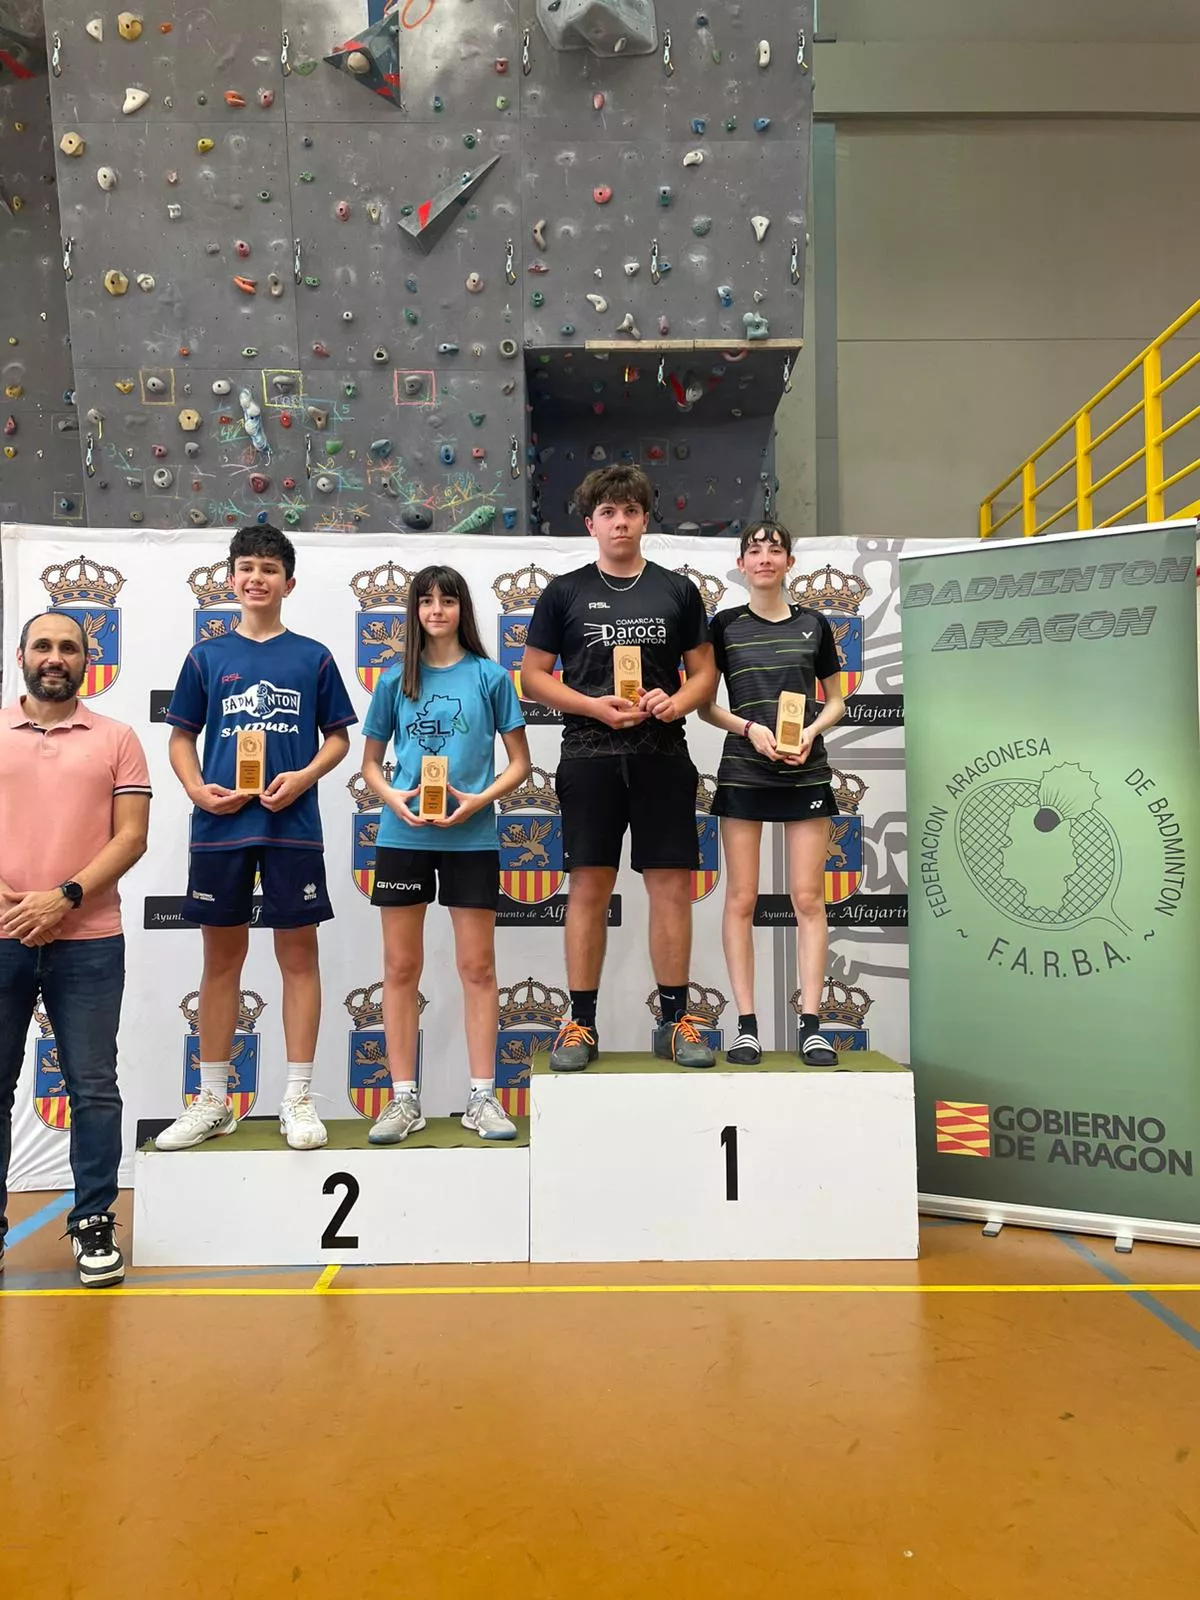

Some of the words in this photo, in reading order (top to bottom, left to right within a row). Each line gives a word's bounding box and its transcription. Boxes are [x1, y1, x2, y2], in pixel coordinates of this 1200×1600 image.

[902, 555, 1193, 610] BADMINTON
[588, 601, 611, 610] RSL
[602, 624, 667, 639] Daroca
[615, 618, 654, 626] COMARCA
[655, 617, 666, 625] DE
[931, 605, 1157, 652] ARAGON
[603, 638, 667, 647] BADMINTON
[405, 719, 451, 740] RSL
[921, 805, 952, 918] FEDERACION
[945, 737, 1051, 800] ARAGONESA
[1125, 768, 1156, 797] DE
[1147, 797, 1187, 917] BADMINTON
[376, 880, 422, 891] GIVOVA
[526, 909, 537, 919] de
[759, 910, 796, 921] Ayunta
[992, 1105, 1166, 1144] GOBIERNO
[720, 1125, 738, 1201] 1
[993, 1134, 1036, 1162] DE
[1047, 1138, 1193, 1177] ARAGON
[320, 1171, 361, 1249] 2
